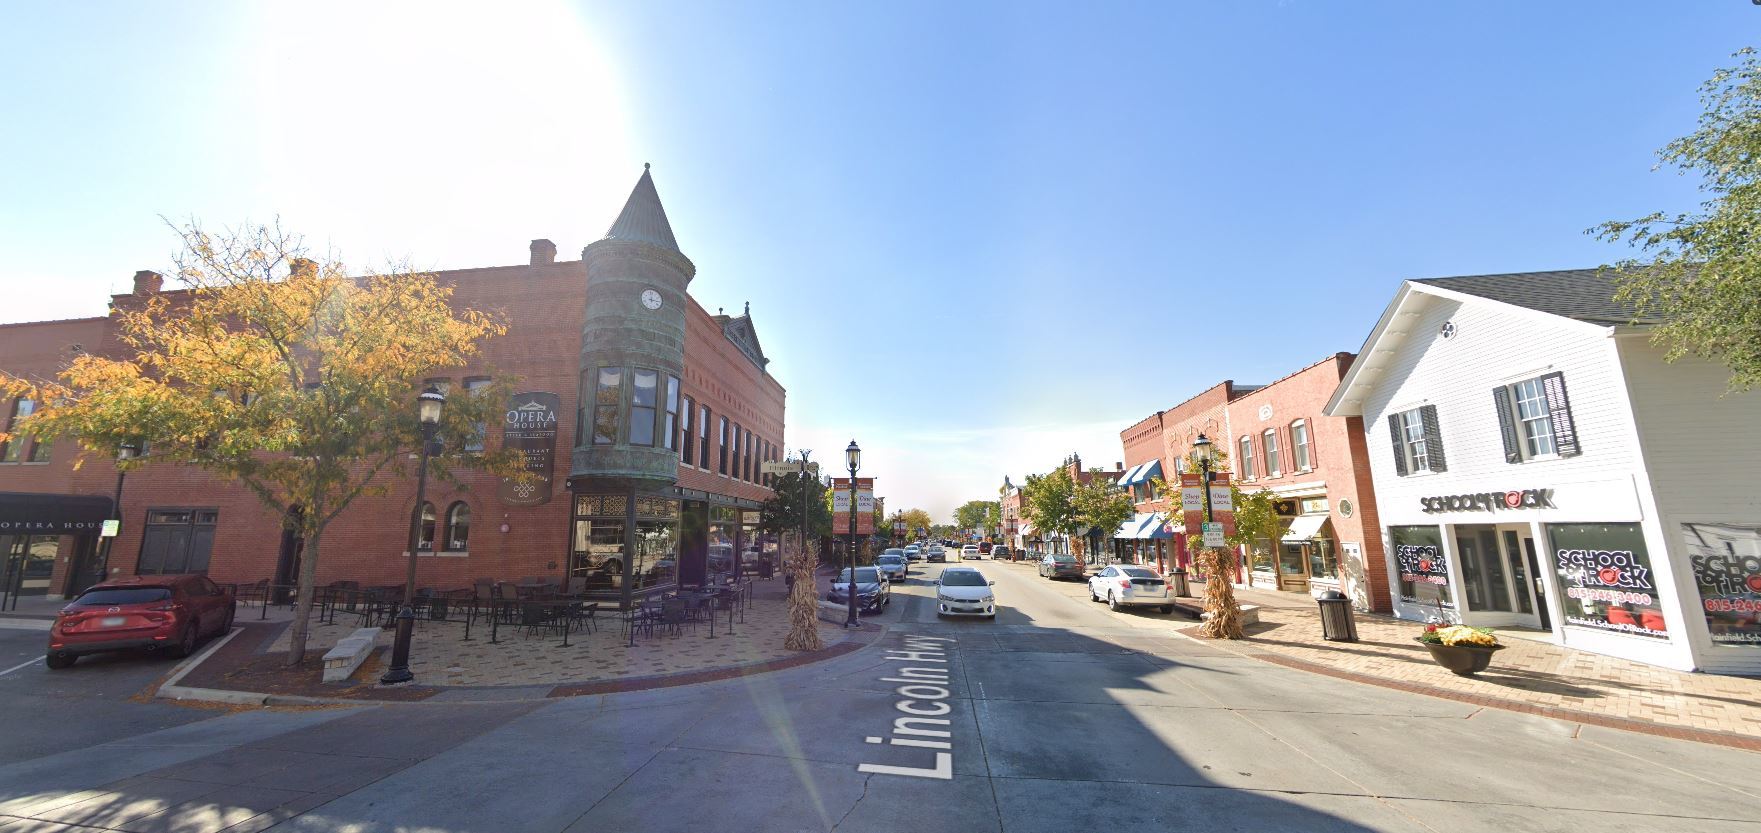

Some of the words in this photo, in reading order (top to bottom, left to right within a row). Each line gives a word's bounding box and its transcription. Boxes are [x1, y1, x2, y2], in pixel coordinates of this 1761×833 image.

[506, 410, 556, 423] OPERA
[1491, 488, 1558, 509] ROCK
[1396, 544, 1437, 562] SCHOOL
[1558, 549, 1642, 568] SCHOOL
[1585, 564, 1652, 588] ROCK
[1567, 587, 1652, 606] 815-246-3400
